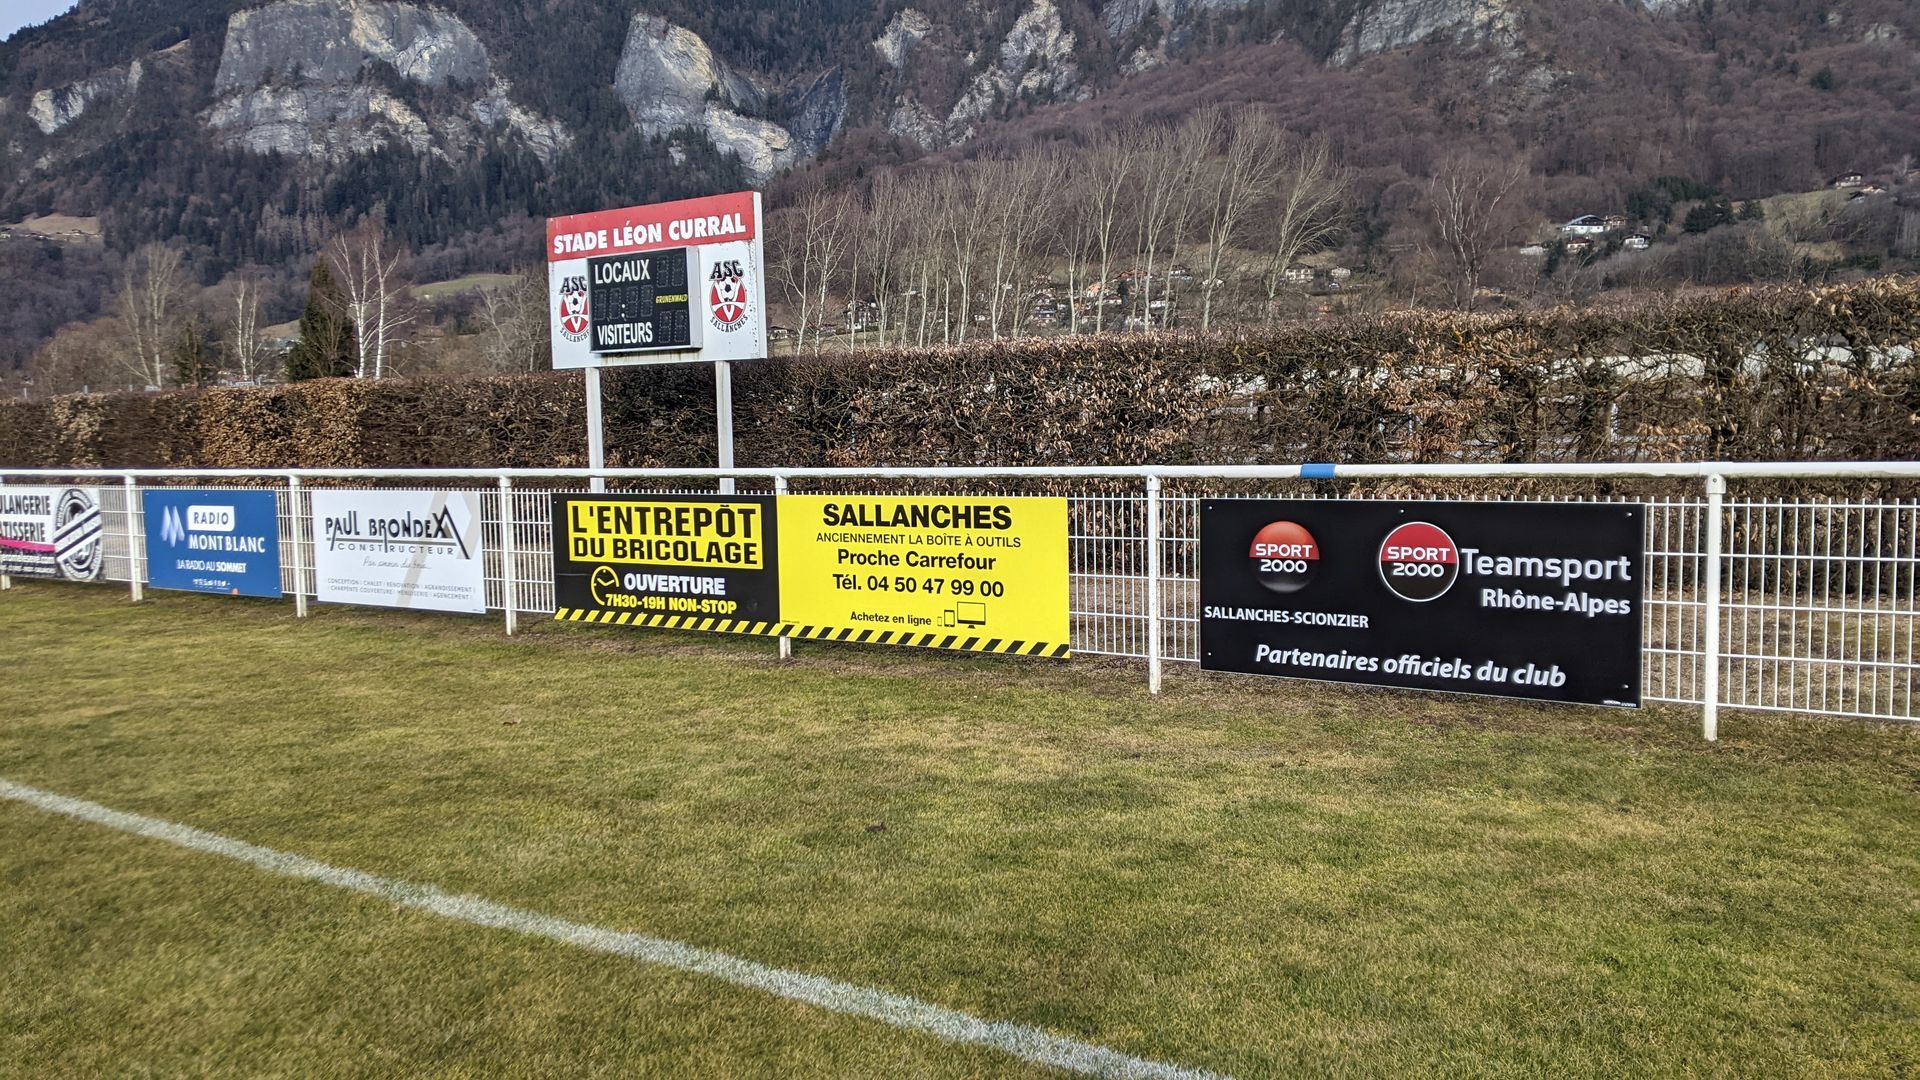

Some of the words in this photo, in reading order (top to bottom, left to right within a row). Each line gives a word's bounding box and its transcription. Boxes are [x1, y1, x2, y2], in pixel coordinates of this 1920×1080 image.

[553, 230, 608, 254] STADE
[613, 220, 662, 247] LÉON
[668, 212, 746, 241] CURRAL
[594, 259, 650, 285] LOCAUX
[709, 260, 744, 281] ASC
[596, 322, 653, 346] VISITEURS
[710, 314, 748, 333] SALLANCHES
[193, 511, 229, 525] RADIO
[572, 504, 756, 539] L'ENTREPÔT
[823, 503, 1012, 530] SALLANCHES
[188, 534, 224, 551] MONT
[225, 536, 266, 553] BLANC
[325, 510, 360, 551] PAUL
[368, 505, 469, 559] BRONDEX
[816, 532, 906, 545] ANCIENNEMENT
[908, 535, 924, 546] LA
[926, 533, 962, 547] BOÎTE
[965, 533, 974, 547] À
[976, 536, 1021, 548] OUTILS
[337, 543, 454, 555] CONSTRUCTEUR
[574, 537, 605, 558] DU
[612, 538, 758, 565] BRICOLAGE
[837, 548, 900, 567] Proche
[905, 550, 997, 571] Carrefour
[1255, 543, 1313, 558] SPORT
[1387, 546, 1451, 562] SPORT
[176, 559, 185, 569] LA
[185, 559, 205, 571] RADIO
[205, 561, 216, 571] AU
[215, 561, 247, 573] SOMMET
[1260, 558, 1308, 573] 2000
[1392, 562, 1445, 578] 2000
[1461, 548, 1632, 587] Teamsport
[623, 572, 726, 596] OUVERTURE
[832, 573, 862, 590] Tél.
[867, 575, 889, 592] 04
[894, 576, 917, 593] 50
[922, 578, 945, 594] 47
[951, 579, 974, 596] 99
[980, 580, 1004, 598] 00
[605, 593, 666, 610] 7H30-19H
[669, 597, 737, 615] NON-STOP
[1482, 587, 1631, 618] Rhône-Alpes
[850, 611, 889, 623] Achetez
[892, 615, 905, 624] en
[907, 614, 932, 627] ligne
[1204, 605, 1369, 629] SALLANCHES-SCIONZIER
[1255, 644, 1379, 672] Partenaires
[1383, 654, 1472, 681] officiels
[1477, 660, 1509, 683] du
[1513, 663, 1567, 688] club
